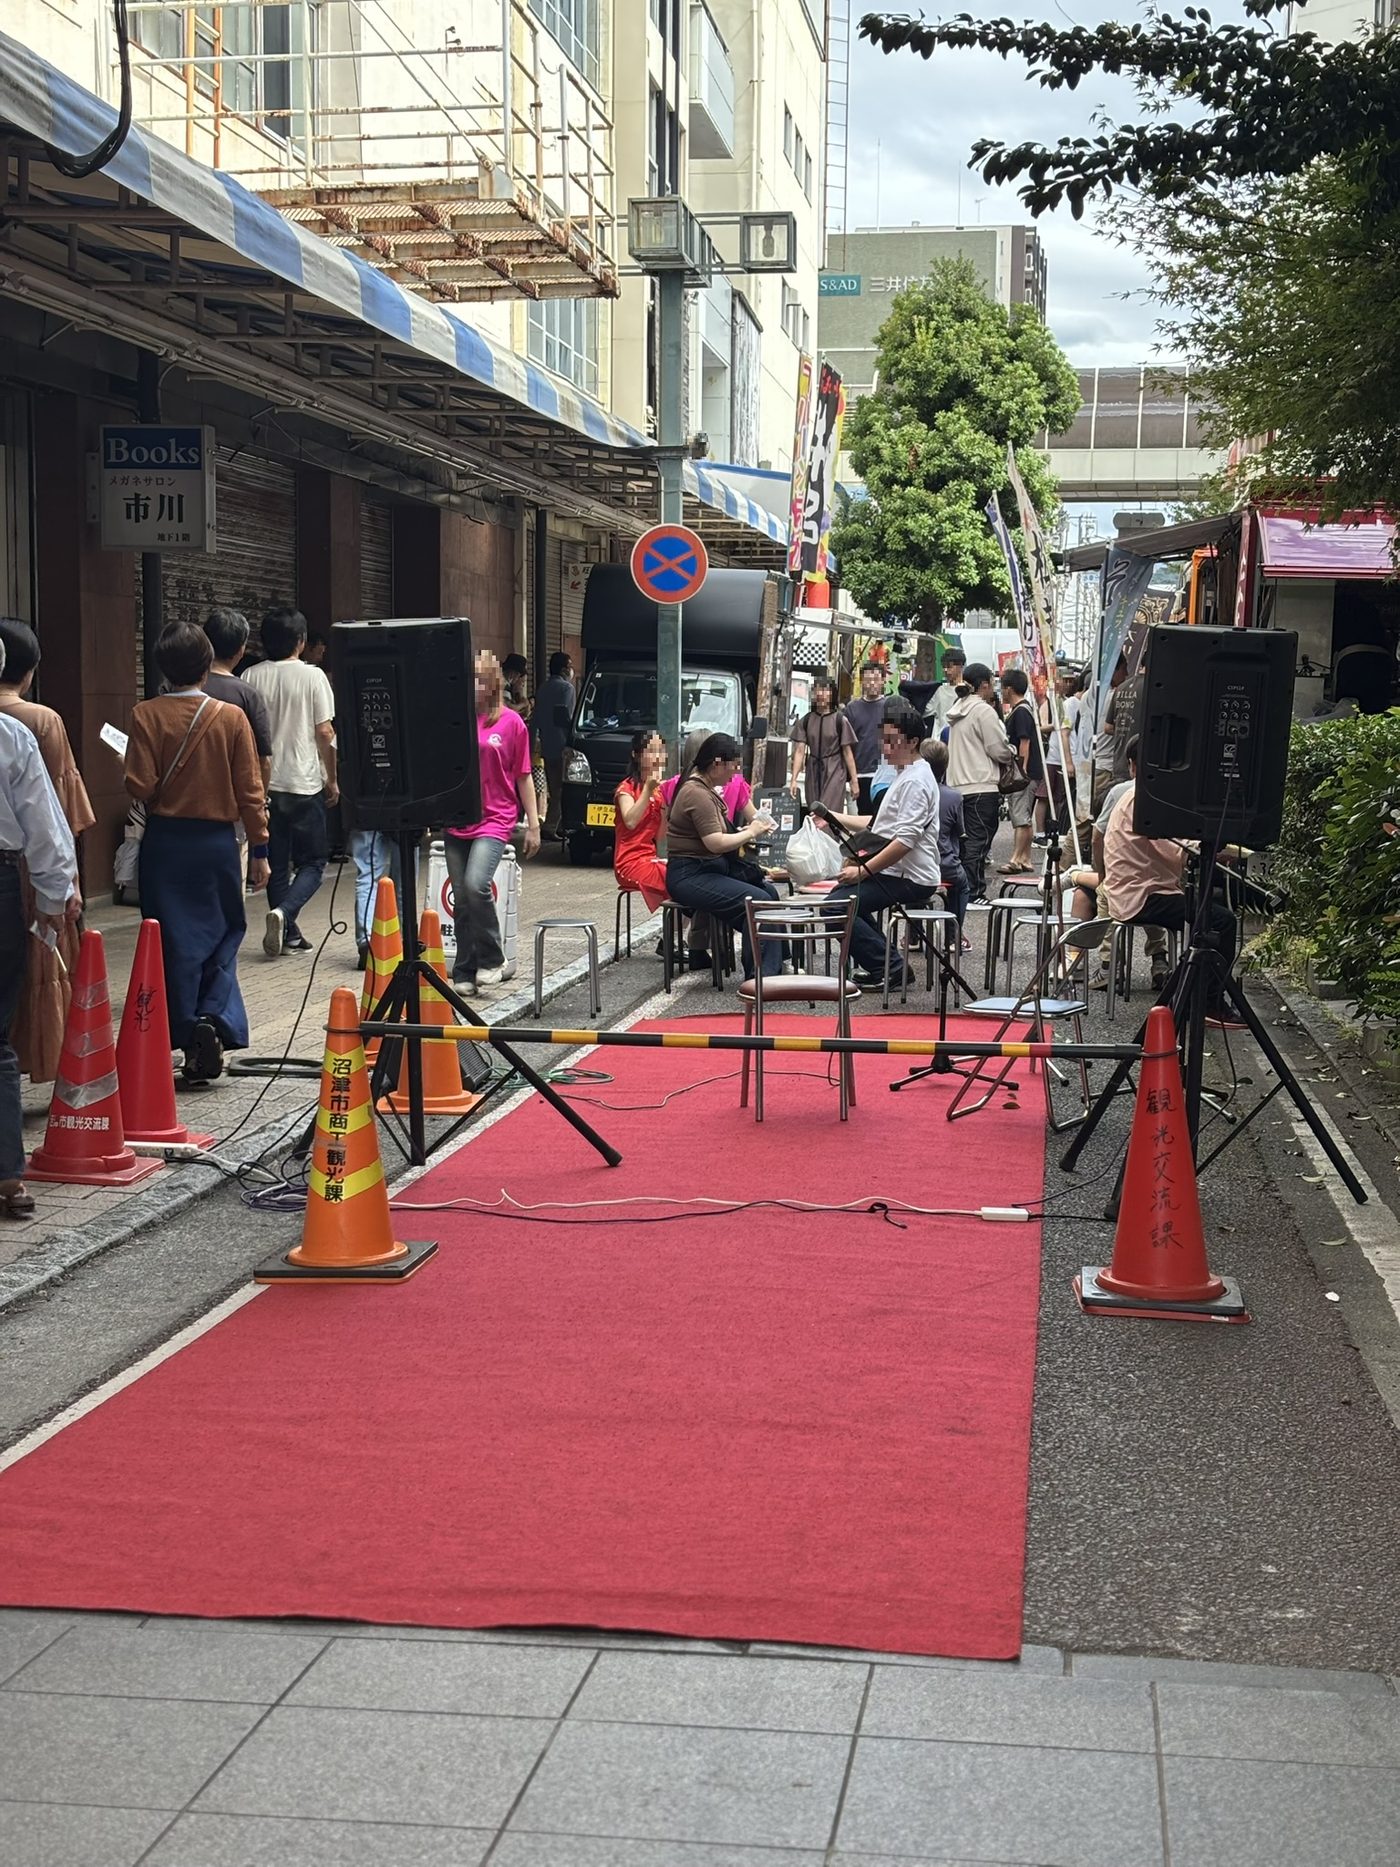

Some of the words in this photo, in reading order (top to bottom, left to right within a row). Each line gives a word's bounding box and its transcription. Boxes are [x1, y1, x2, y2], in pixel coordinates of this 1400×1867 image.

[106, 437, 200, 464] Books
[109, 475, 177, 487] メガネサロン
[122, 492, 185, 524] 市川
[323, 1057, 353, 1204] 沼津市商工観光課
[1146, 1087, 1184, 1249] 観光交流課
